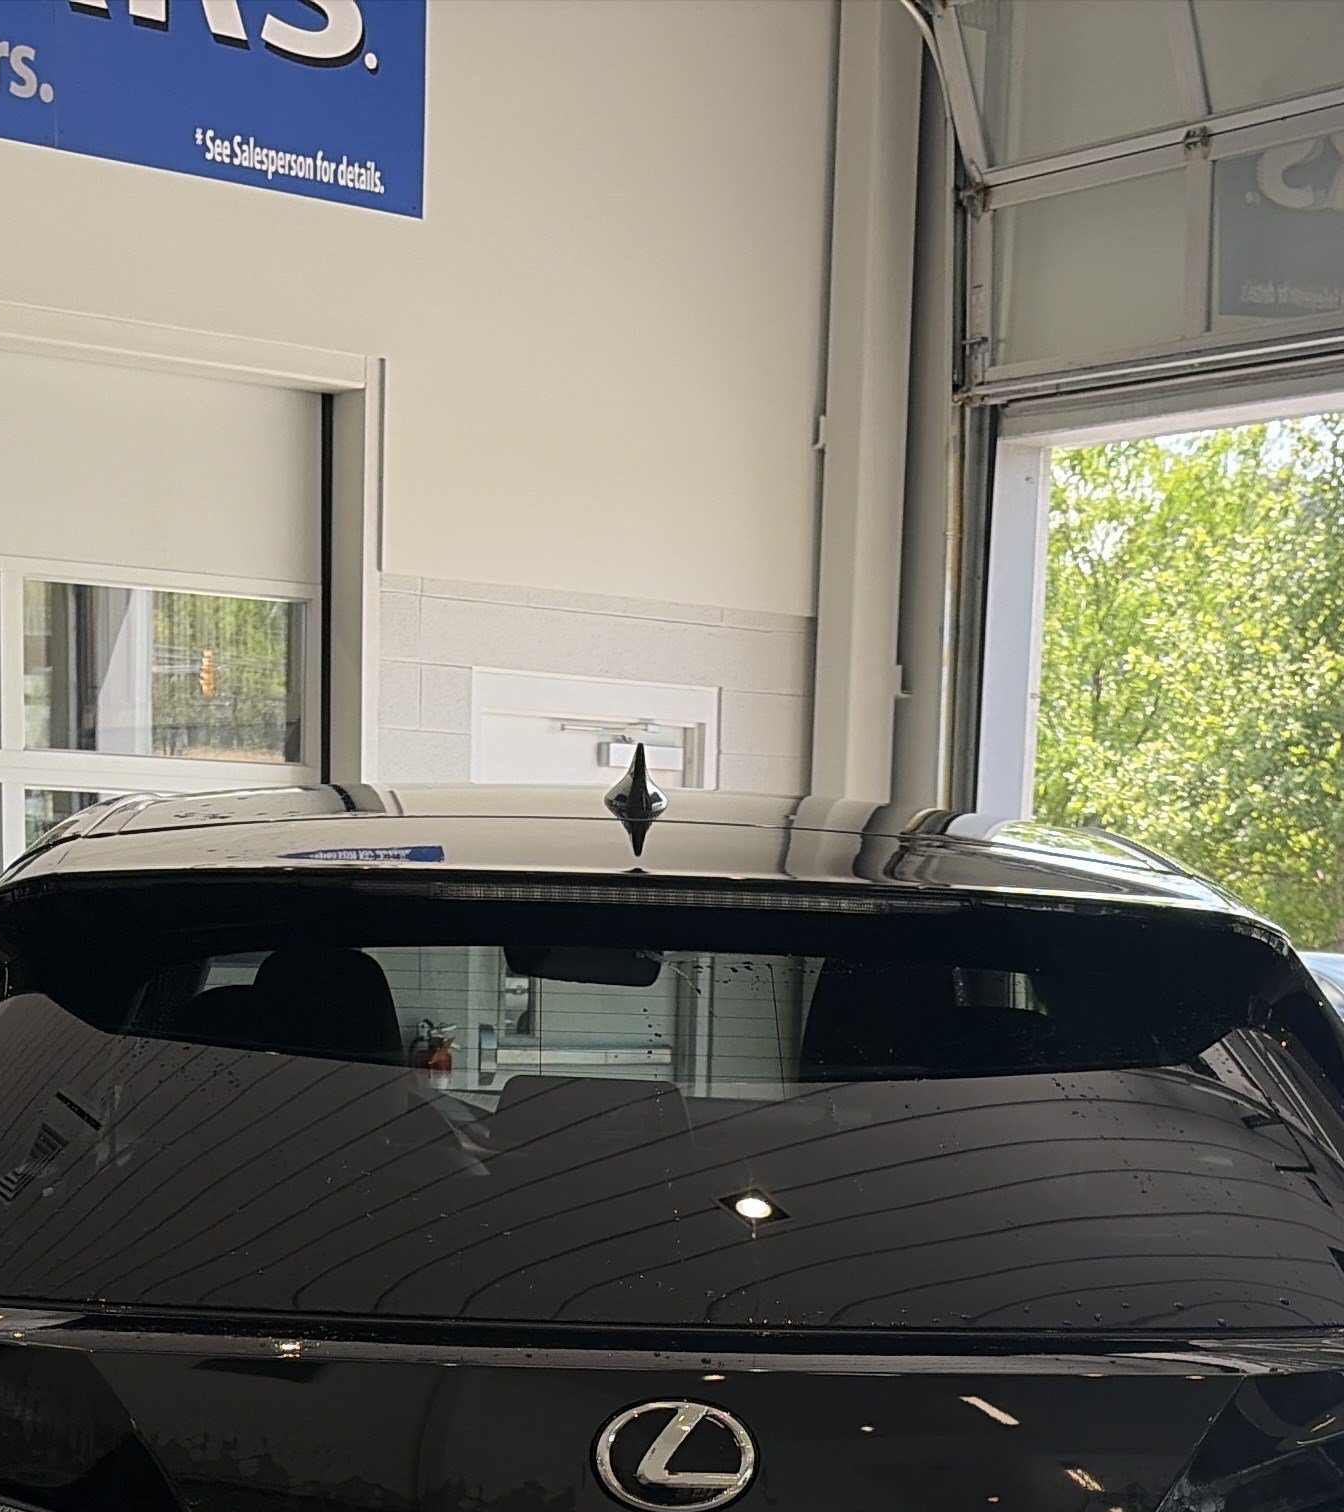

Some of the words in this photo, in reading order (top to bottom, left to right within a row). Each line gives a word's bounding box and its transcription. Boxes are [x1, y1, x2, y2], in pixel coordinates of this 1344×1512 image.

[232, 135, 314, 180] Salesperson
[315, 150, 337, 184] for
[337, 155, 385, 195] details.
